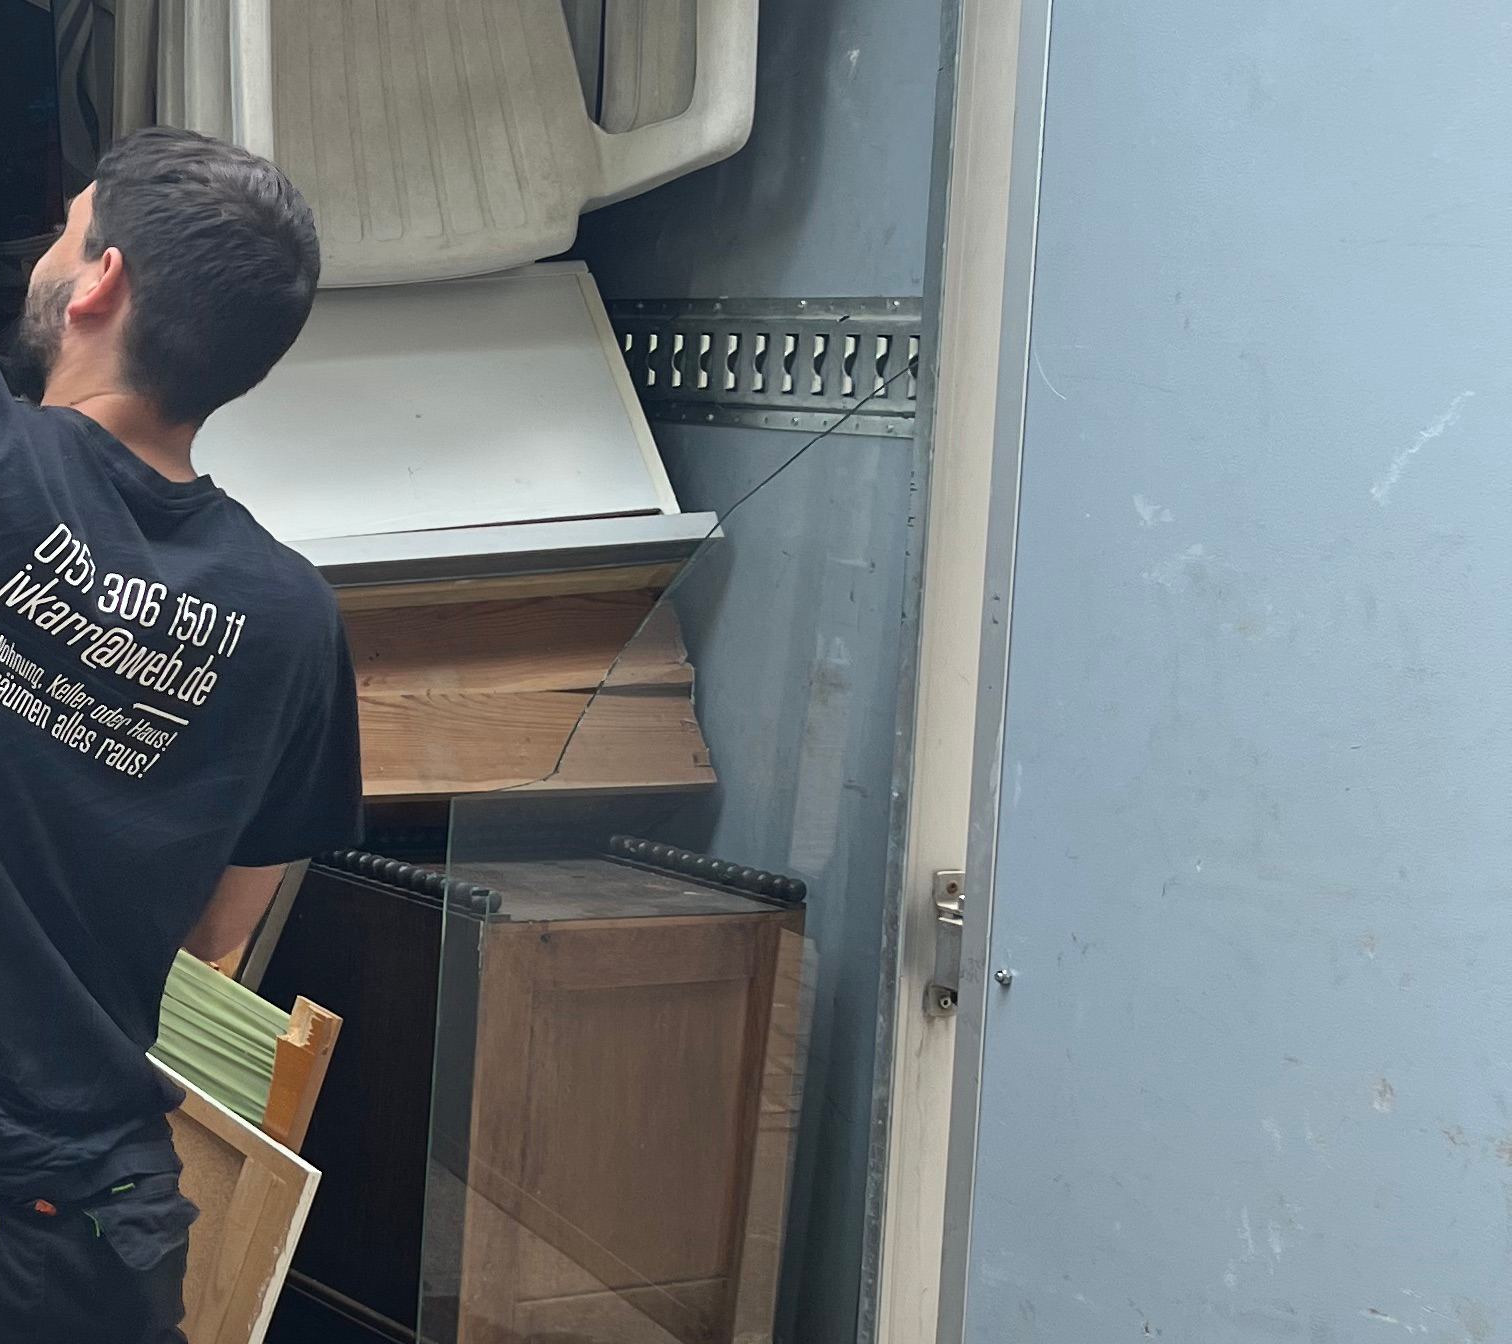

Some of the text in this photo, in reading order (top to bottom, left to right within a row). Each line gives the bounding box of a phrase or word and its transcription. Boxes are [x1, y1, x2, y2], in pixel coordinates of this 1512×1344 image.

[97, 572, 168, 628] 306
[167, 592, 218, 647] 150
[218, 611, 246, 657] 11
[45, 673, 95, 710] Keller
[90, 702, 132, 731] oder
[126, 719, 178, 752] Haus!
[51, 711, 97, 754] alles
[94, 737, 161, 778] raus!
